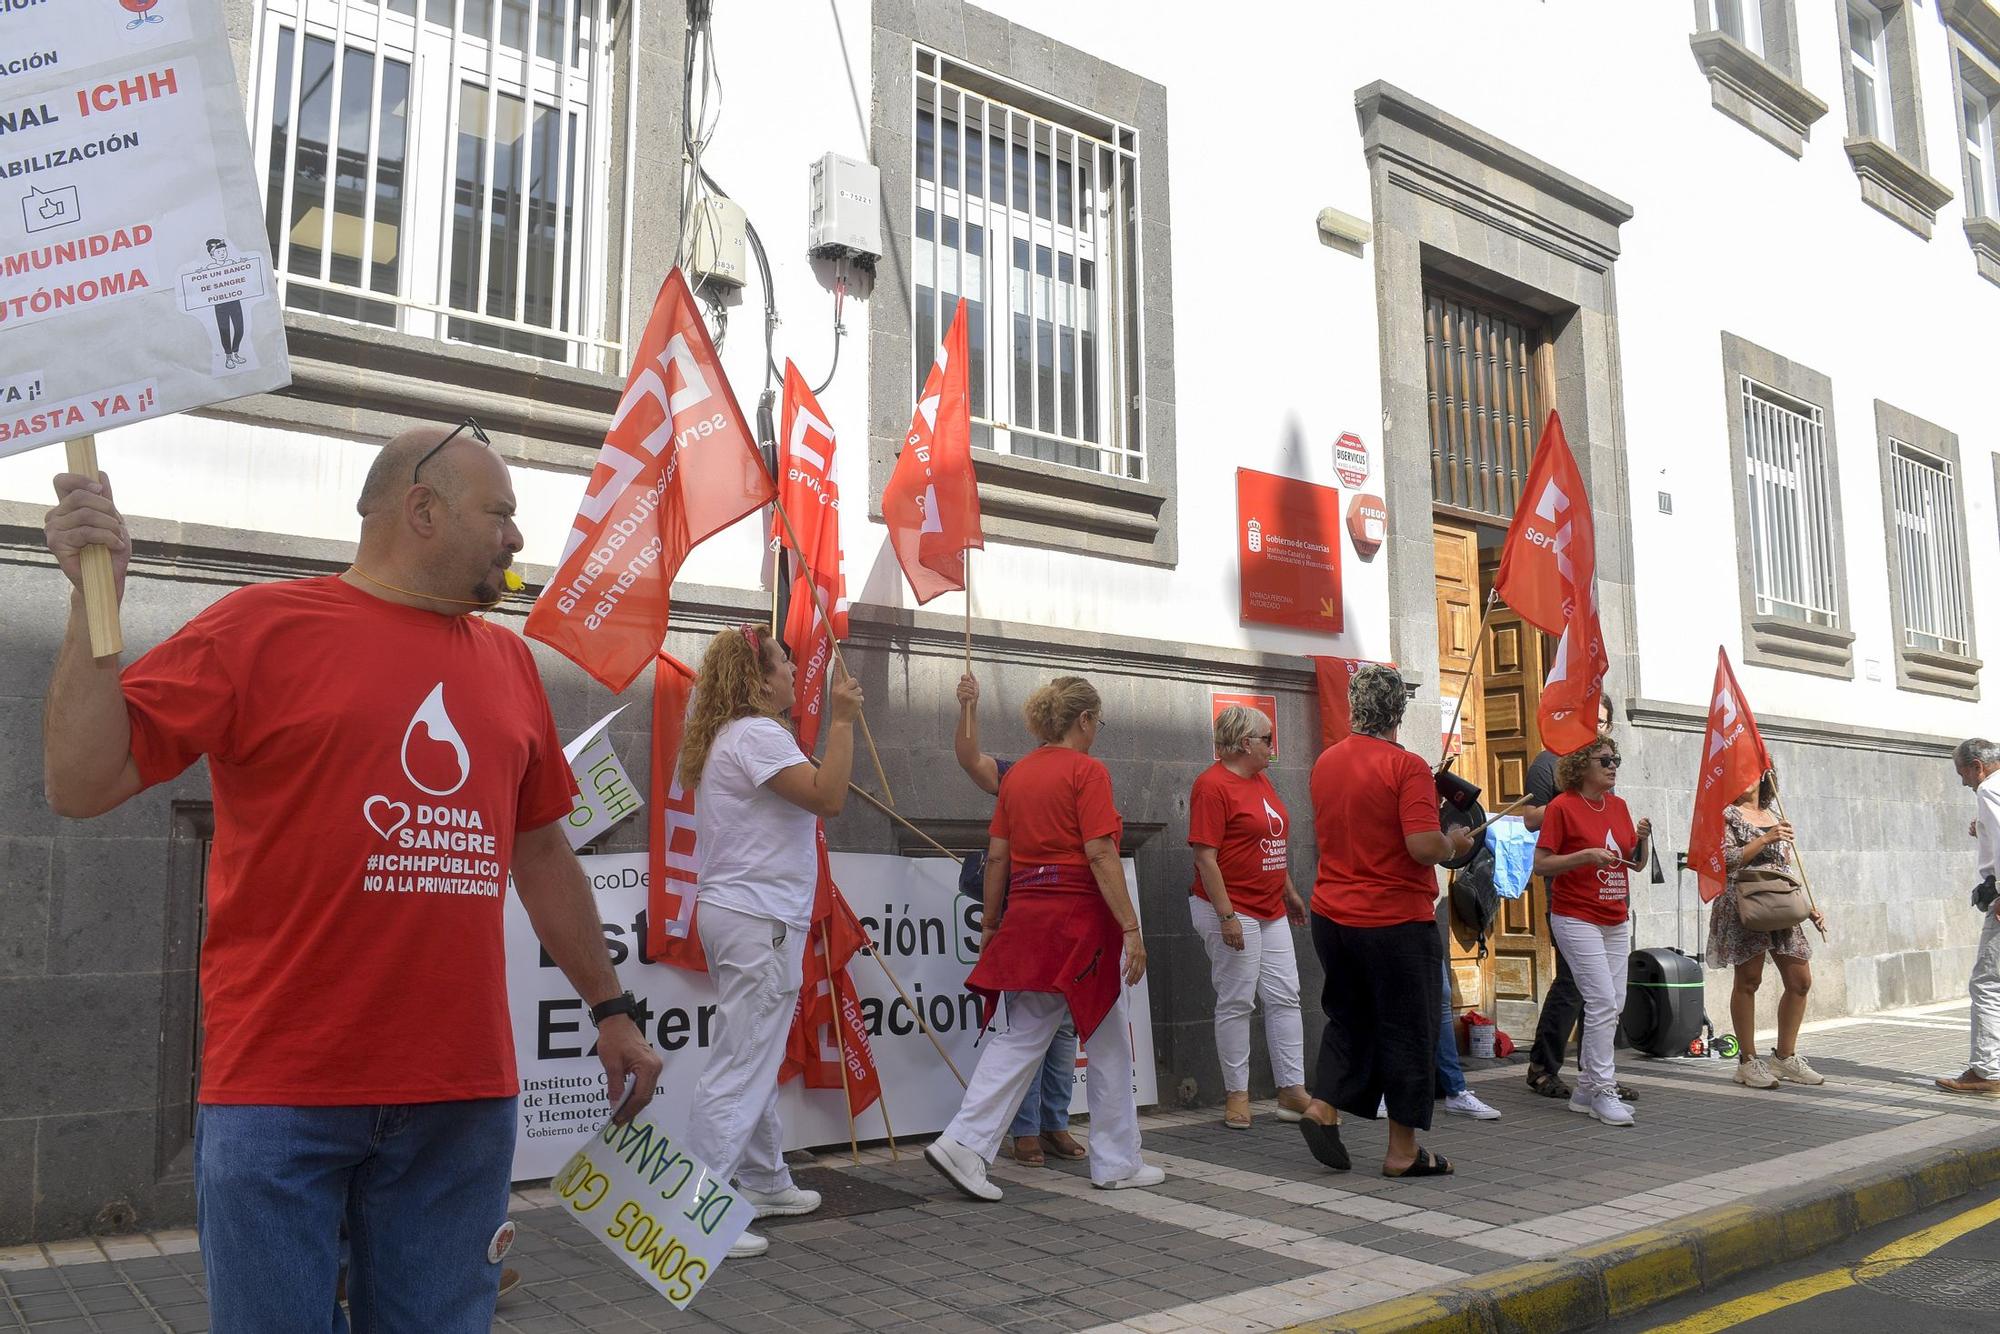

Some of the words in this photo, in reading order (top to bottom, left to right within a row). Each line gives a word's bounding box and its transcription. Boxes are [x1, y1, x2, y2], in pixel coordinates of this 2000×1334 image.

[76, 67, 178, 117] ICHH
[0, 223, 153, 278] MUNIDAD
[210, 270, 222, 278] UN
[224, 263, 251, 275] BANCO
[201, 284, 212, 292] DE
[214, 276, 246, 288] SANGRE
[91, 394, 131, 417] YA
[1360, 507, 1386, 519] FUEGO
[1265, 534, 1296, 547] Gobierno
[1303, 541, 1330, 553] Canarias
[417, 805, 483, 829] DONA
[399, 829, 496, 855] SANGRE
[366, 854, 500, 877] #ICHHPÚBLICO
[363, 876, 383, 892] NO
[385, 877, 395, 891] A
[398, 876, 414, 892] LA
[417, 876, 499, 898] PRIVATIZACIÓN
[523, 1076, 592, 1091] Instituto
[524, 1095, 543, 1108] de
[524, 1114, 534, 1128] y
[527, 1124, 573, 1138] Gobierno
[577, 1124, 589, 1133] de
[683, 1177, 734, 1236] DE
[606, 1200, 707, 1301] SOMOS
